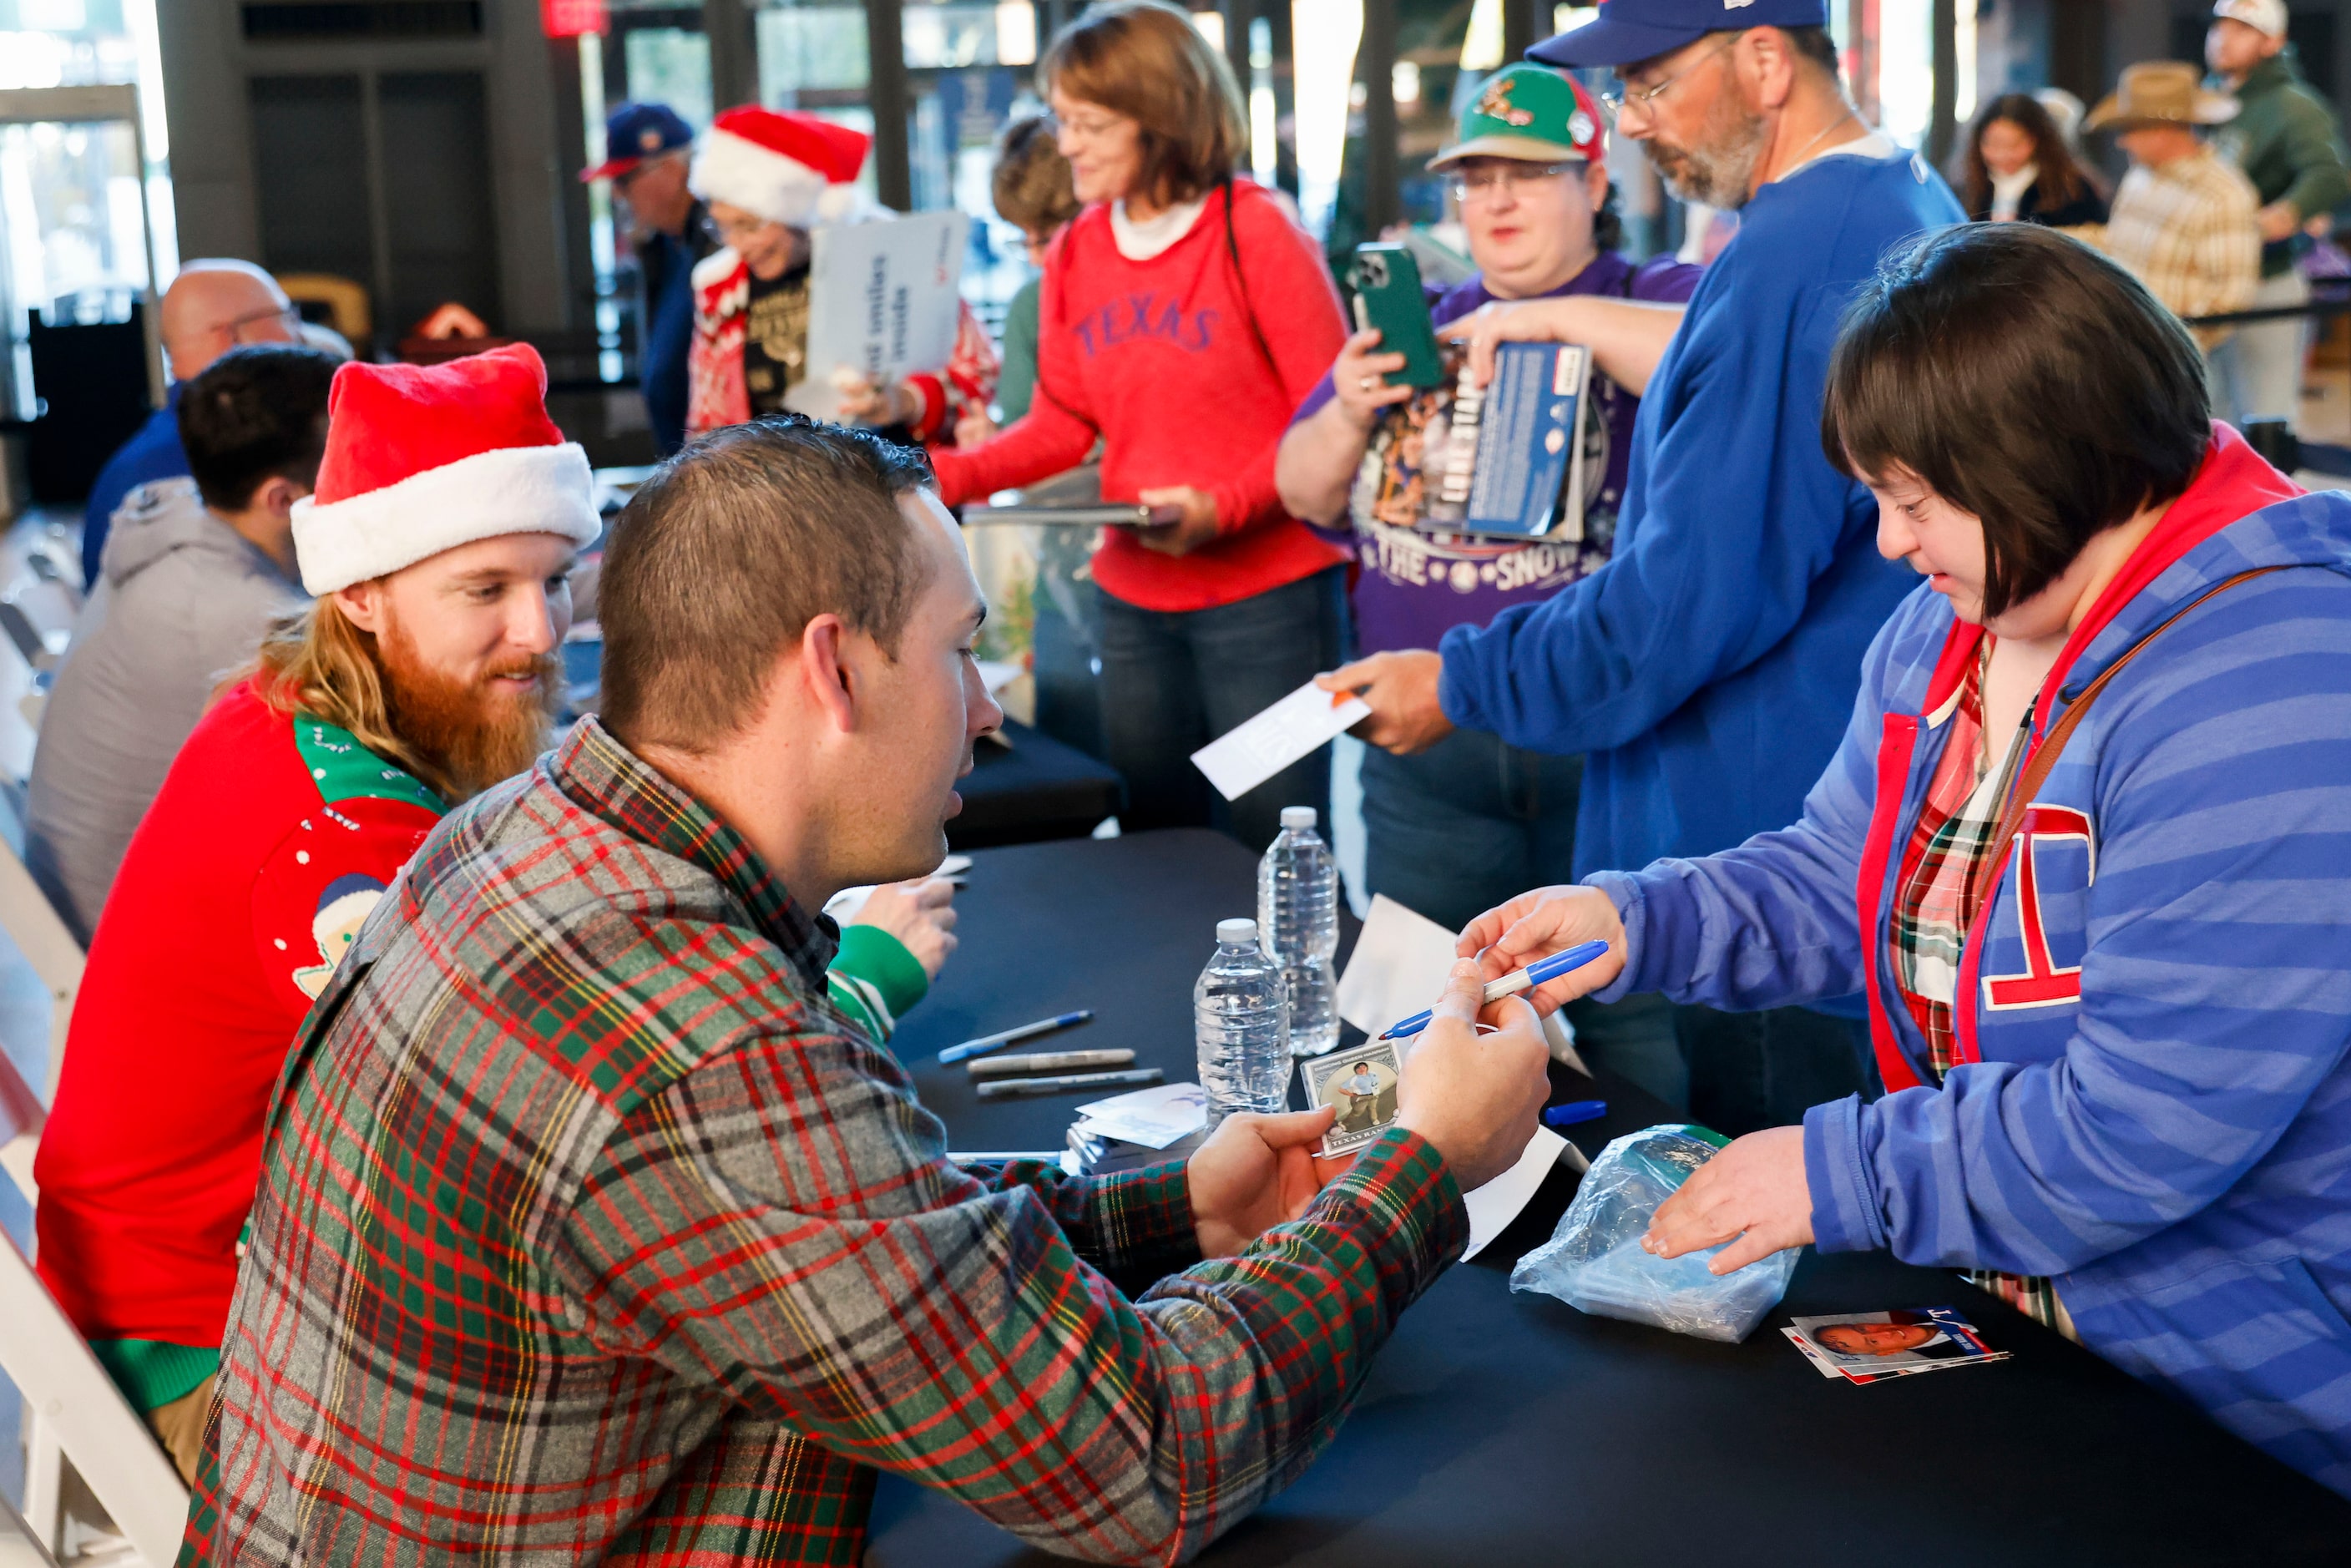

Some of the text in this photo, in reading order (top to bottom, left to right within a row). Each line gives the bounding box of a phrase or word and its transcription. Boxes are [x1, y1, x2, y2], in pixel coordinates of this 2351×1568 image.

[1074, 291, 1220, 357] TEXAS
[1377, 536, 1428, 586] THE
[1314, 1046, 1390, 1072] DANCING QUEEN HANNAH
[1332, 1133, 1363, 1147] TEXAS
